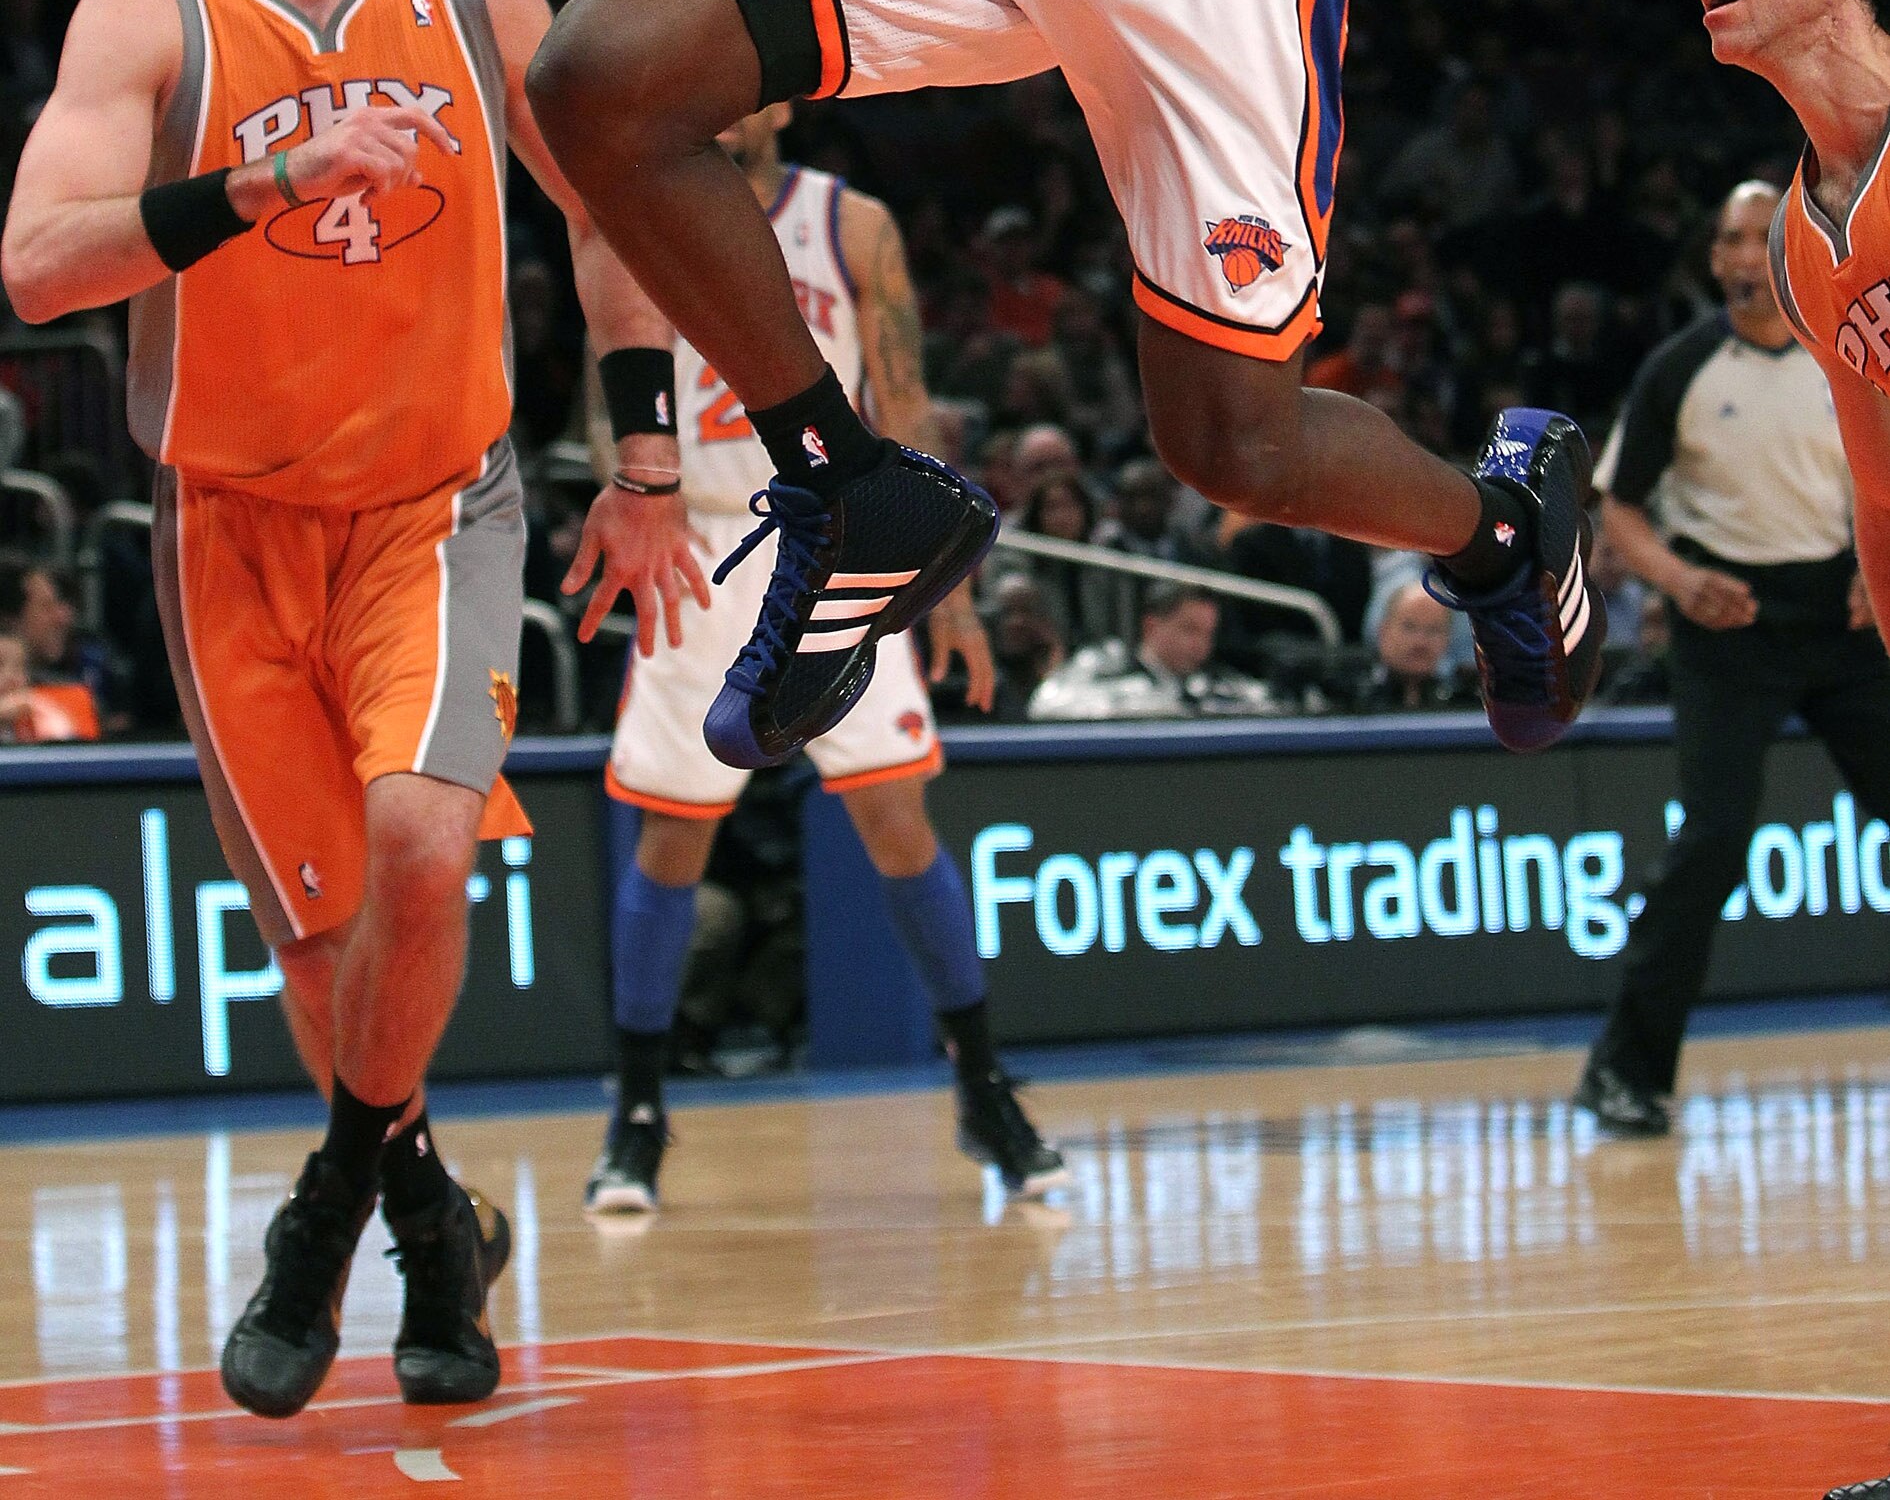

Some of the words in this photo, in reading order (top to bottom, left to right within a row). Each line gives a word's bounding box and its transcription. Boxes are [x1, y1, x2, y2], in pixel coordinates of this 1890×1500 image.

[313, 191, 381, 266] 4
[1203, 217, 1284, 270] KNICKS
[971, 822, 1264, 959] Forex
[1664, 790, 1890, 921] orl
[22, 808, 537, 1077] alpi
